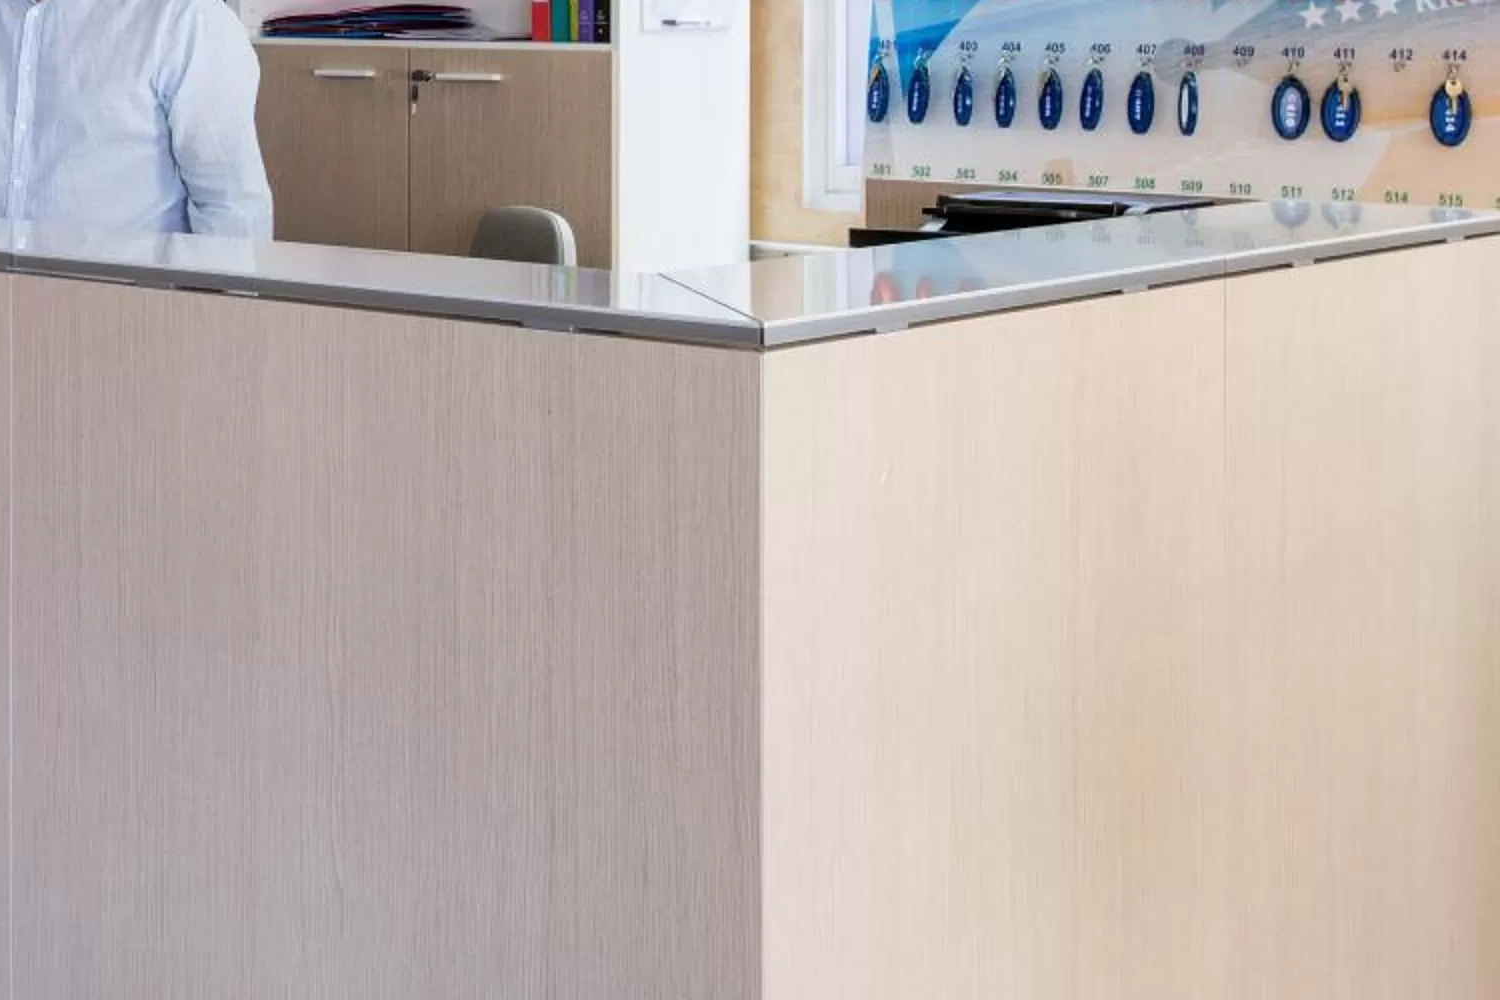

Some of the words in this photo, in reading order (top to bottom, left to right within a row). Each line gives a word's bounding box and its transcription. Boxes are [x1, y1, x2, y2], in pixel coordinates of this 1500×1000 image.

[1045, 42, 1066, 53] 405
[1137, 44, 1157, 56] 407
[1232, 46, 1255, 57] 409
[1282, 48, 1305, 59] 410
[1333, 48, 1355, 60] 411
[1389, 49, 1413, 61] 412
[1443, 50, 1467, 62] 414
[1229, 183, 1252, 195] 510
[1281, 185, 1303, 198] 511
[1331, 188, 1355, 200] 512
[1385, 191, 1409, 203] 514
